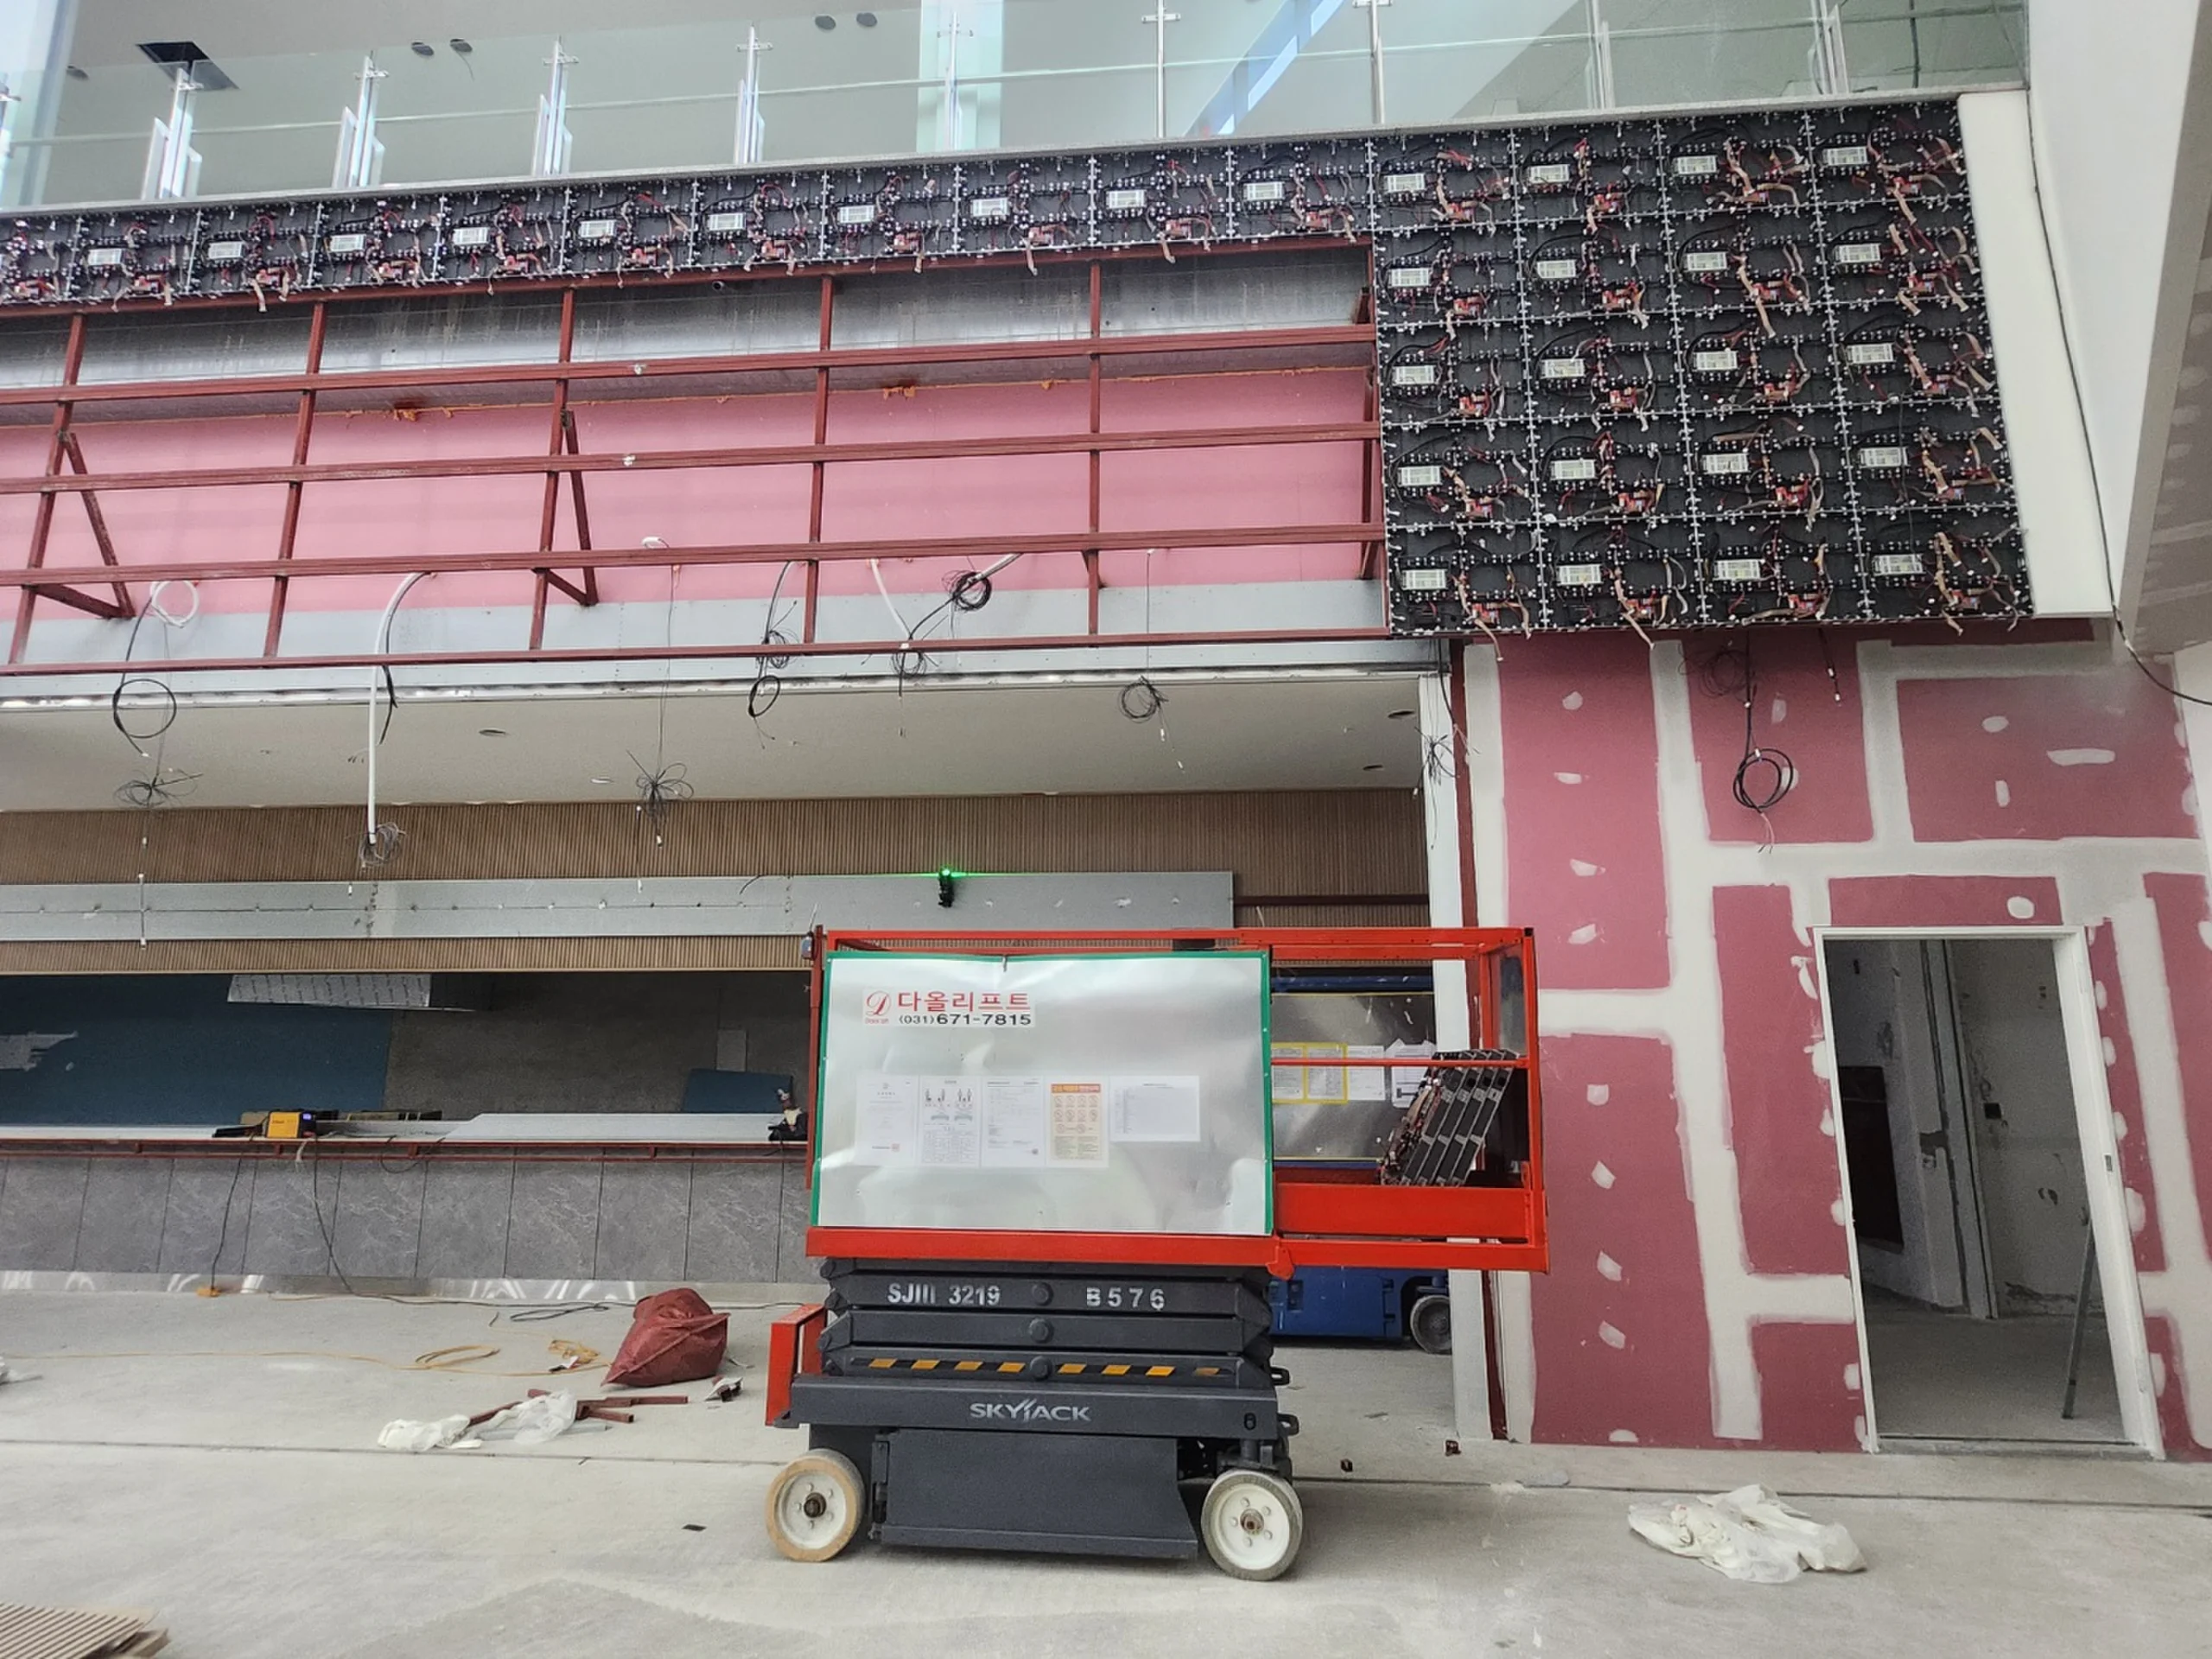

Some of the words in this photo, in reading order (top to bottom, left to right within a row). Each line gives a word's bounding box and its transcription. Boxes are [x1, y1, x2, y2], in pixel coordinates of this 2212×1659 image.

[897, 991, 1032, 1013] 다올리프트
[949, 1285, 1001, 1306] 3219
[969, 1398, 1092, 1423] SKYJACK
